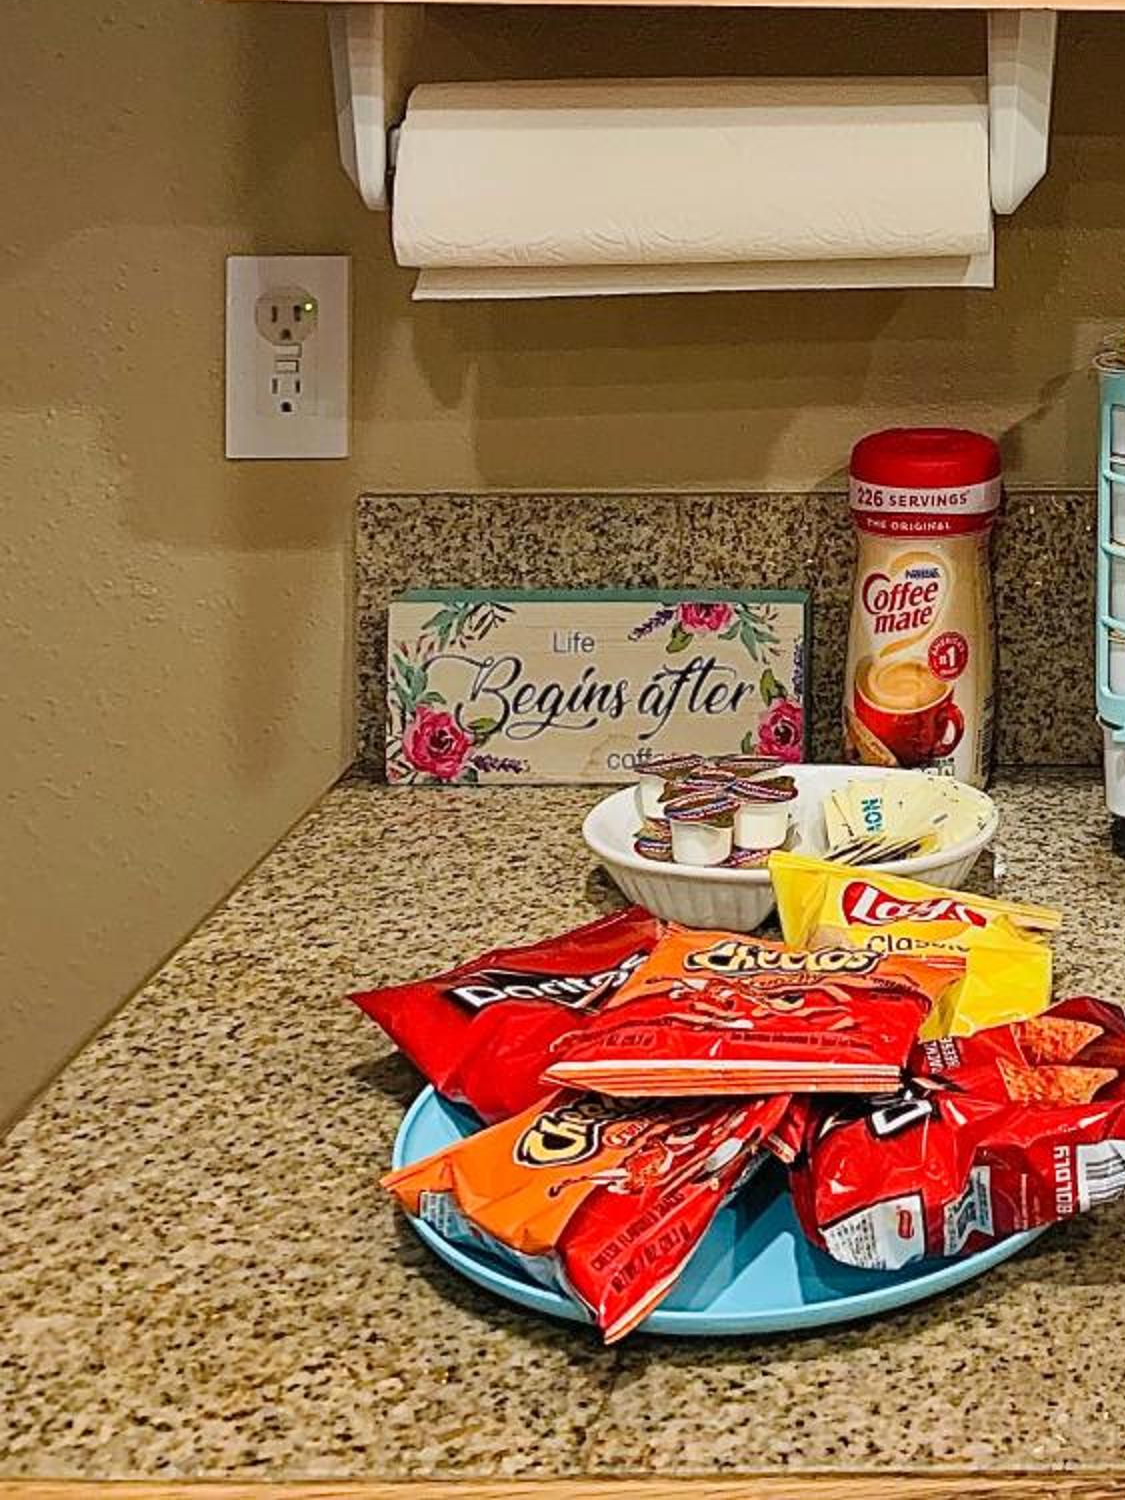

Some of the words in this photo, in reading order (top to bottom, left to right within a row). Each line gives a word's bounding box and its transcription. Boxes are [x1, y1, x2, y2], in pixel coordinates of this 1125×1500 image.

[857, 483, 884, 507] 226
[887, 492, 968, 507] SERVINGS
[891, 521, 951, 531] ORIGINAL
[862, 572, 939, 615] Coffee
[874, 604, 932, 634] mate
[552, 631, 595, 653] Life
[424, 653, 629, 740] Begins
[638, 655, 755, 741] after
[607, 746, 670, 771] coff
[453, 954, 649, 1008] Doritos
[1052, 1145, 1073, 1213] BOLDLY
